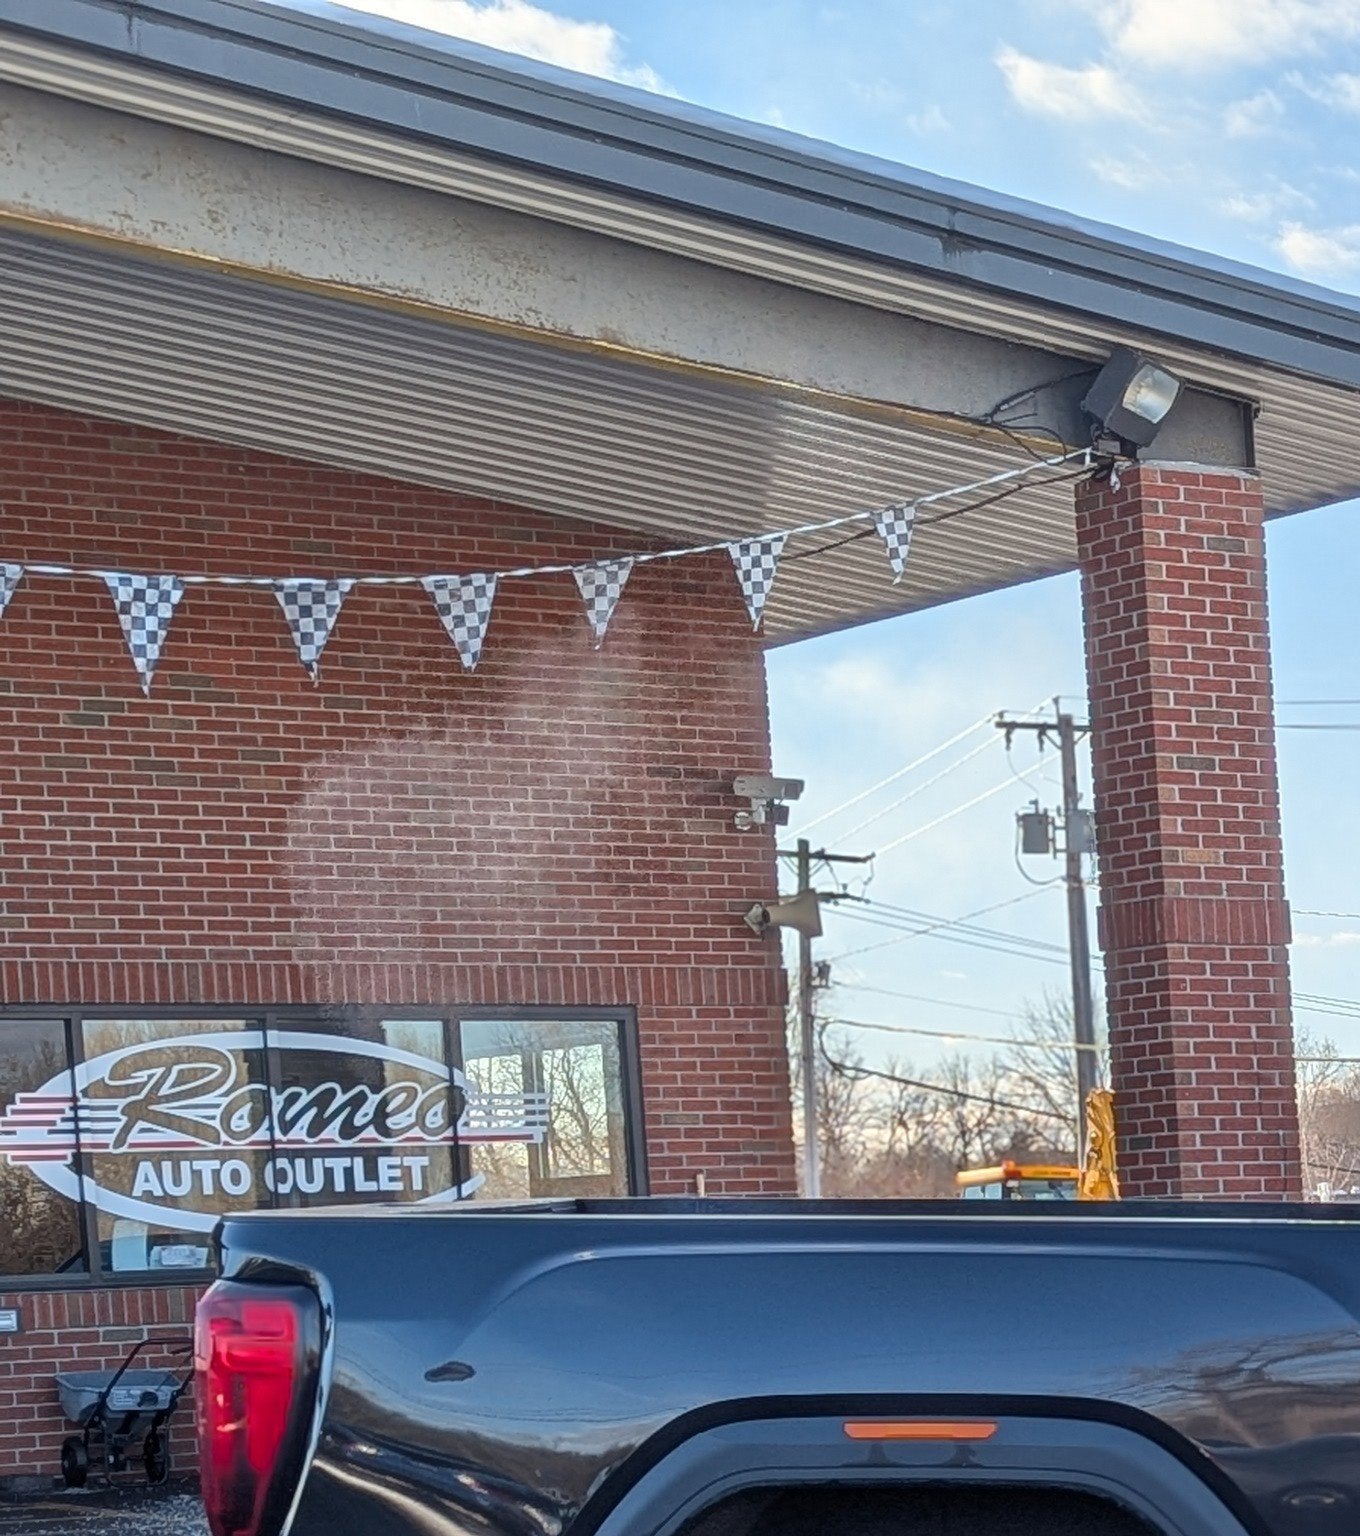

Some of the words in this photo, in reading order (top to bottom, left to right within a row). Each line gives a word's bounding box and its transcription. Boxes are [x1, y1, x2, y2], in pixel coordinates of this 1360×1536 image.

[104, 1045, 469, 1154] Romeo
[132, 1159, 252, 1198] AUTO
[265, 1156, 430, 1195] OUTLET
